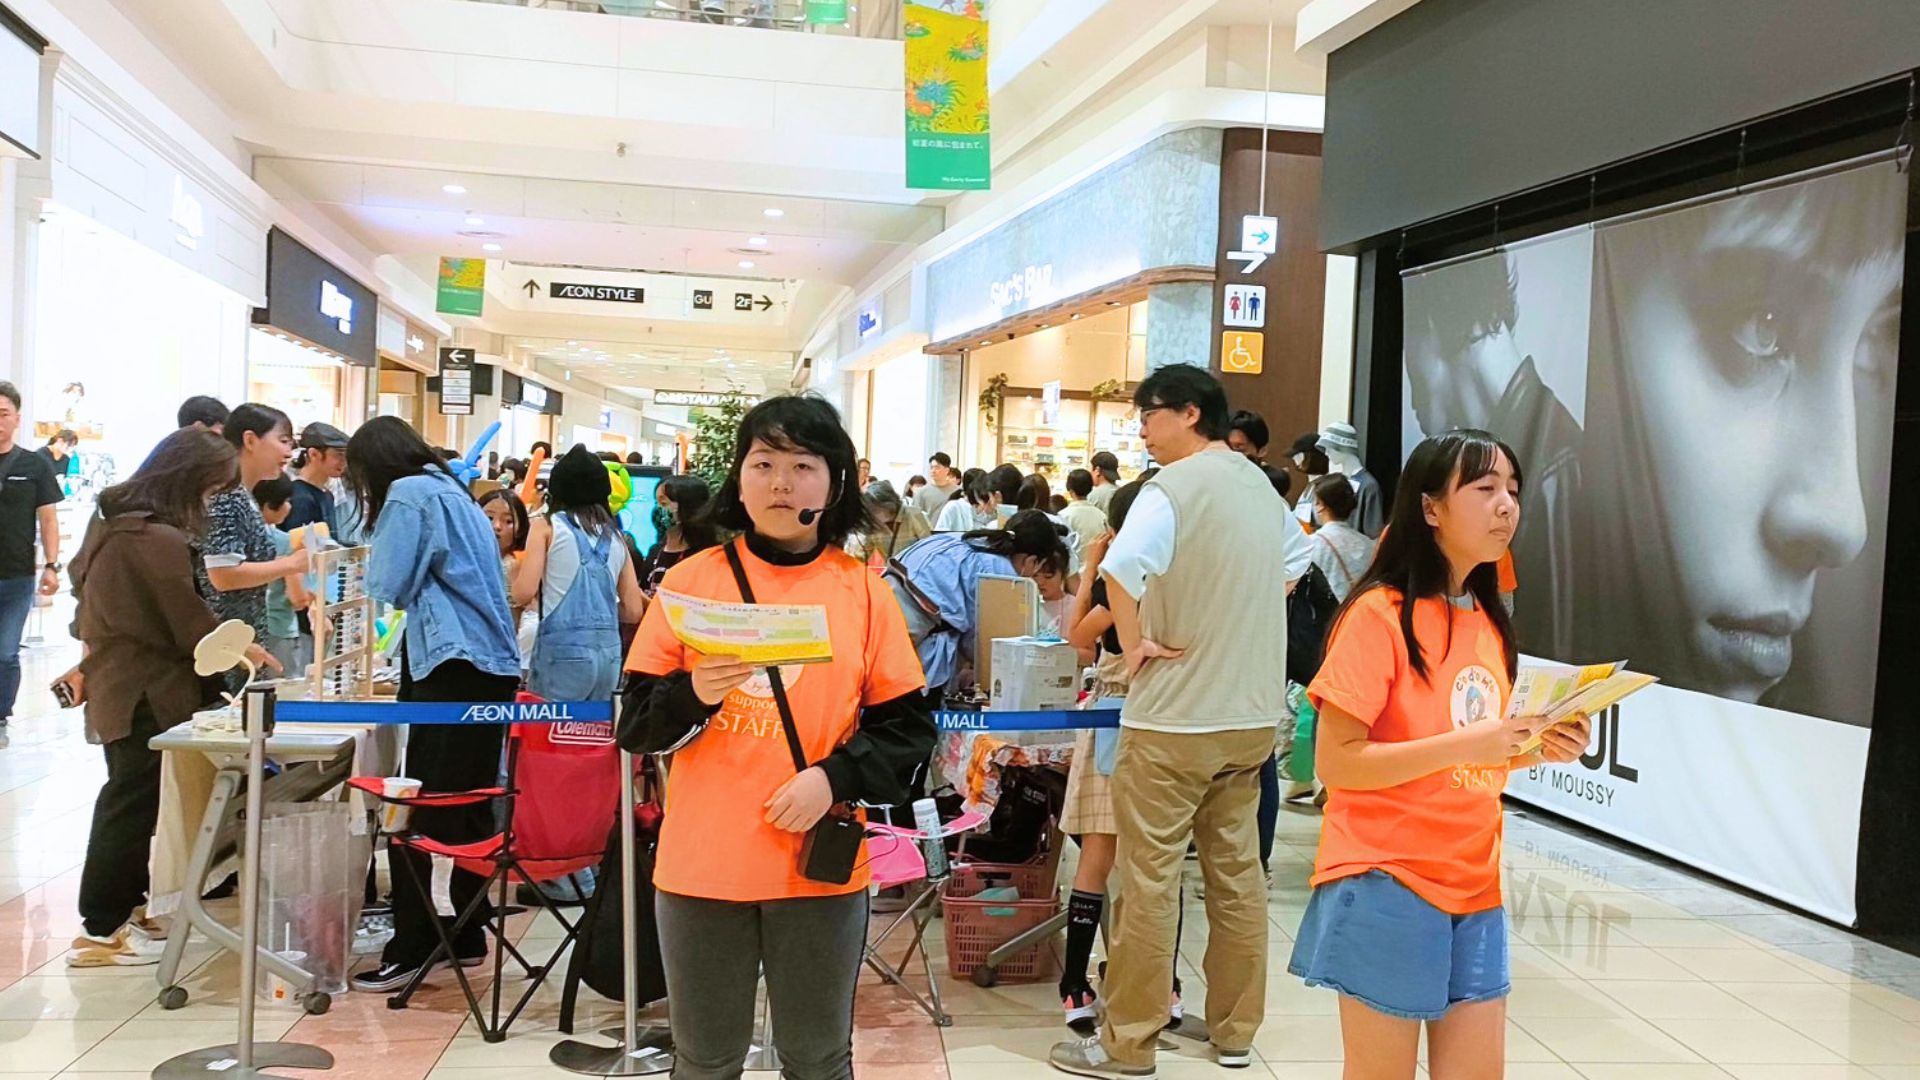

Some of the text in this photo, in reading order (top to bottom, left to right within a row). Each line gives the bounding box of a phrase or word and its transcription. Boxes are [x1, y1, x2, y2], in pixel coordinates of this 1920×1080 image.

[597, 288, 636, 301] STYLE
[694, 294, 712, 305] GU
[736, 296, 752, 307] 2F
[728, 693, 778, 711] suppor
[519, 704, 574, 720] MALL
[714, 710, 785, 739] STAFF
[942, 714, 989, 729] MALL
[1528, 764, 1616, 808] BY MOUSSY
